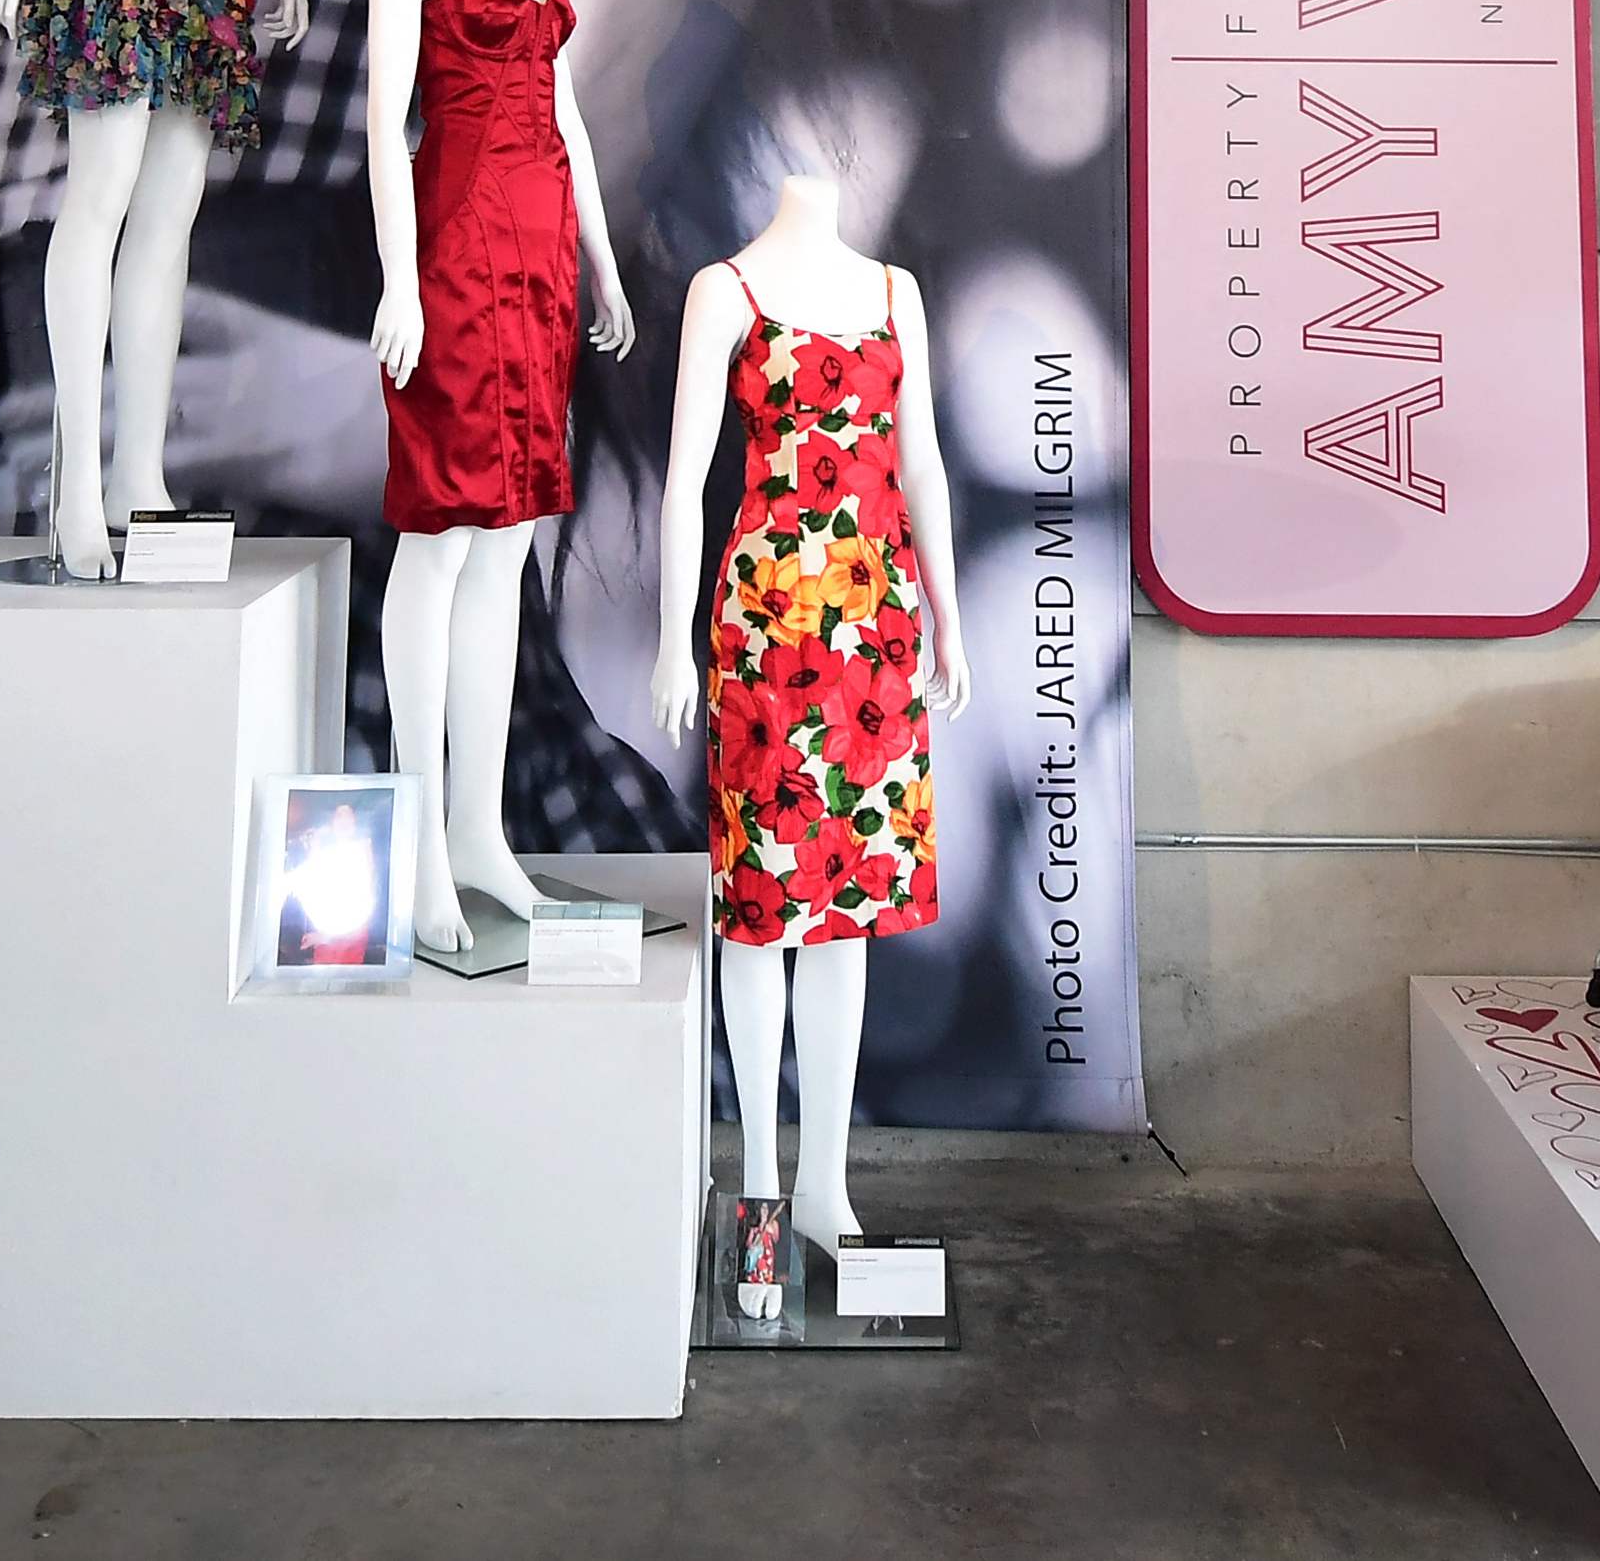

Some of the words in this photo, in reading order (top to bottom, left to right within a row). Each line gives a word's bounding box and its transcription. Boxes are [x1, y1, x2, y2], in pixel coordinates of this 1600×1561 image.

[1227, 83, 1262, 456] PROPERTY
[1299, 78, 1446, 515] AMY
[1034, 351, 1073, 559] MILGRIM
[1036, 575, 1075, 728] JARED
[1039, 742, 1080, 903] Credit:
[1045, 918, 1086, 1065] Photo
